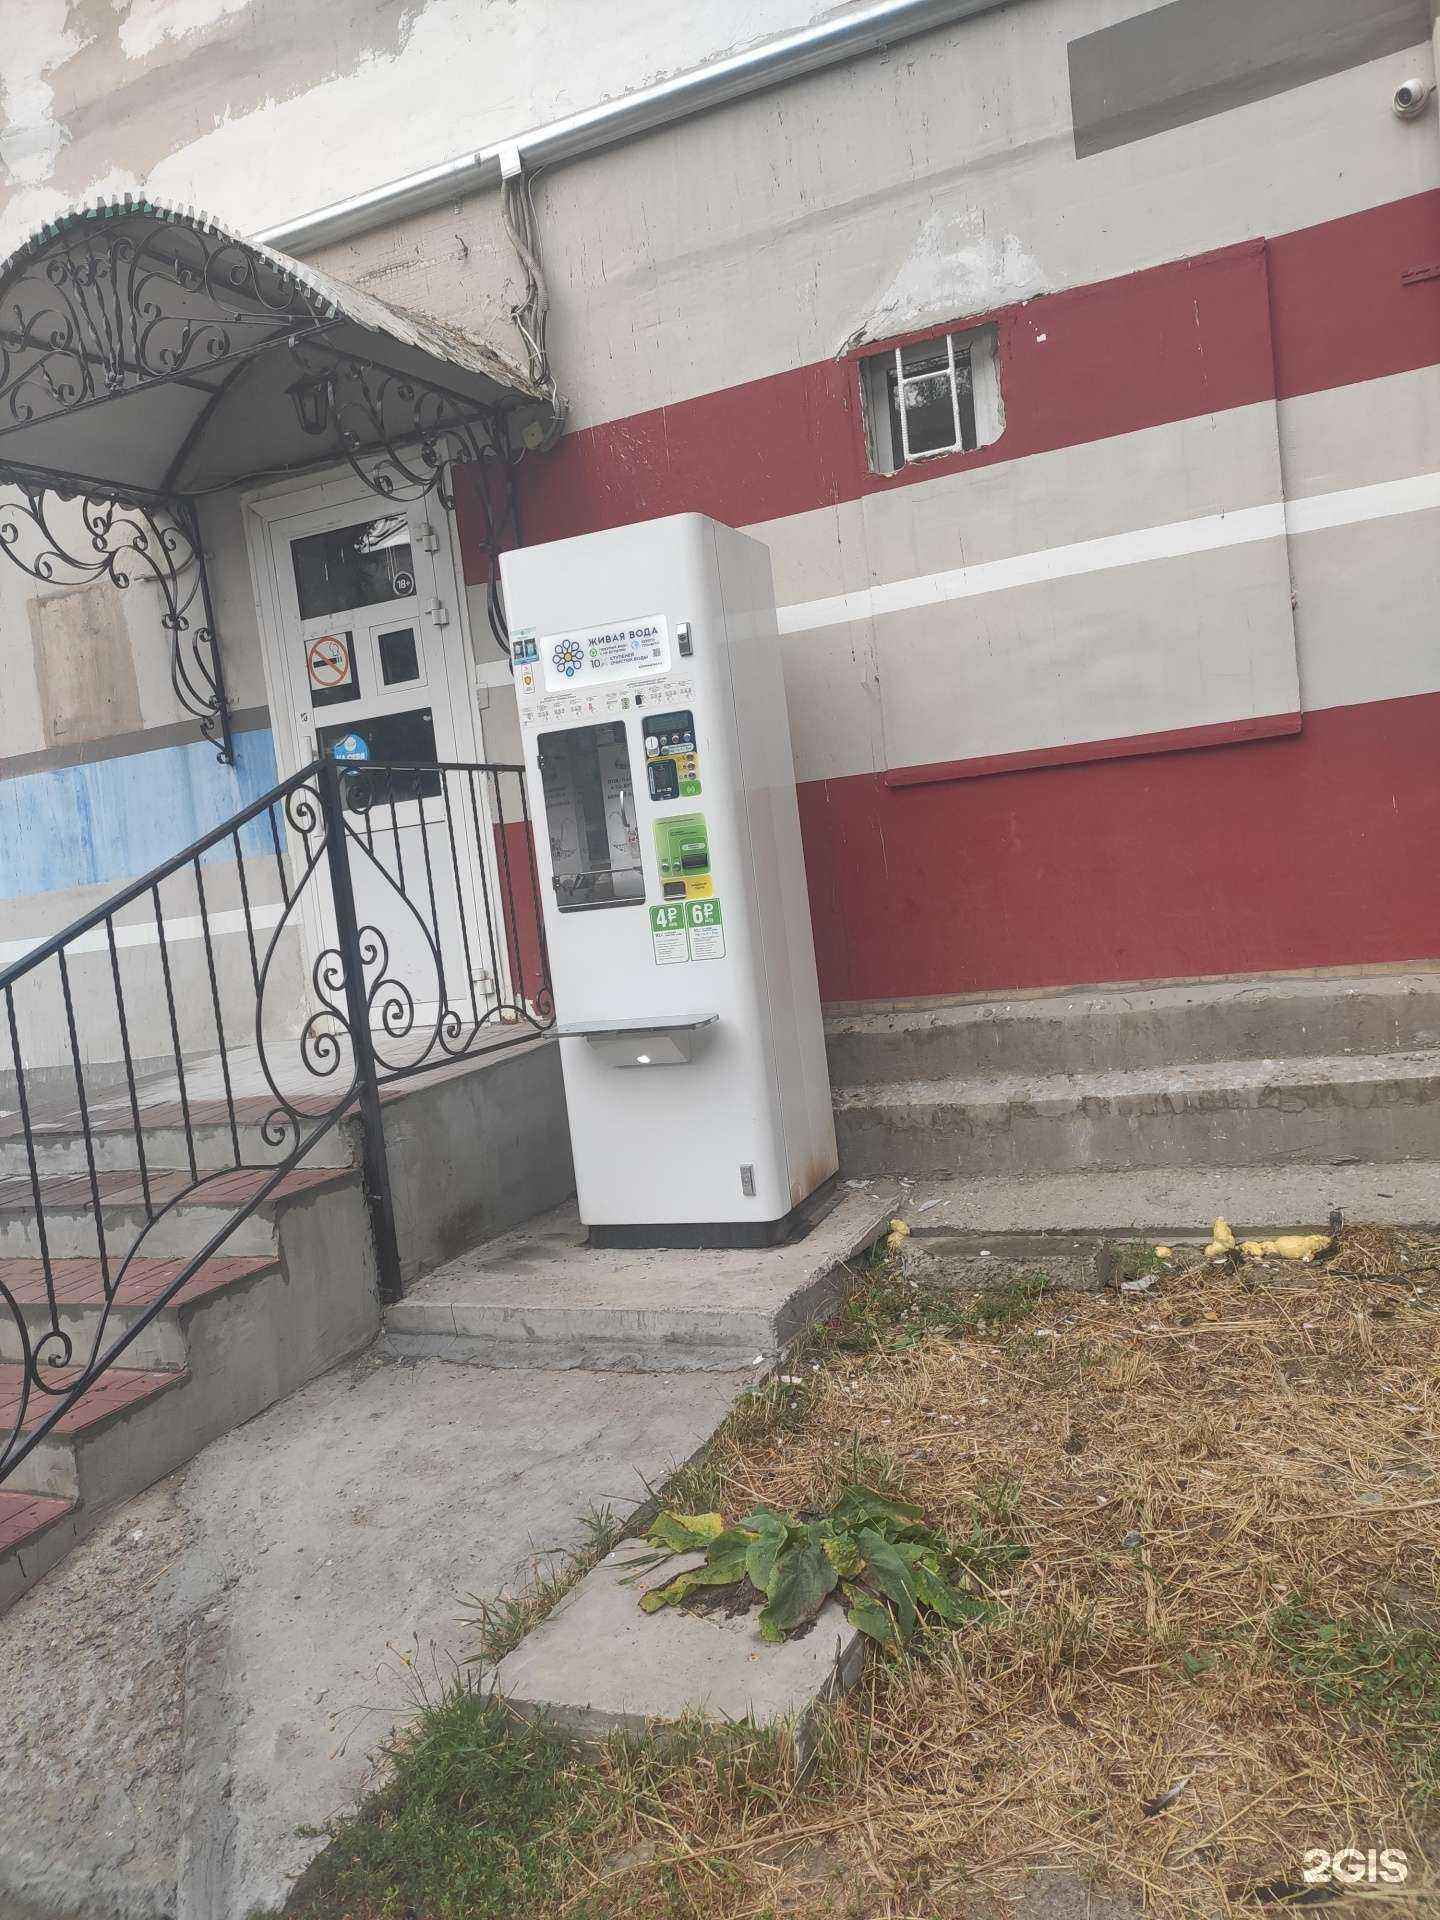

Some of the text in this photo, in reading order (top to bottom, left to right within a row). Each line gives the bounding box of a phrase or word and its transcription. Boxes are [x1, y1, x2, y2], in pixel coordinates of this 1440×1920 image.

[396, 579, 411, 589] 18+
[588, 632, 625, 647] ЖИВАЯ
[629, 627, 658, 639] ВОДА
